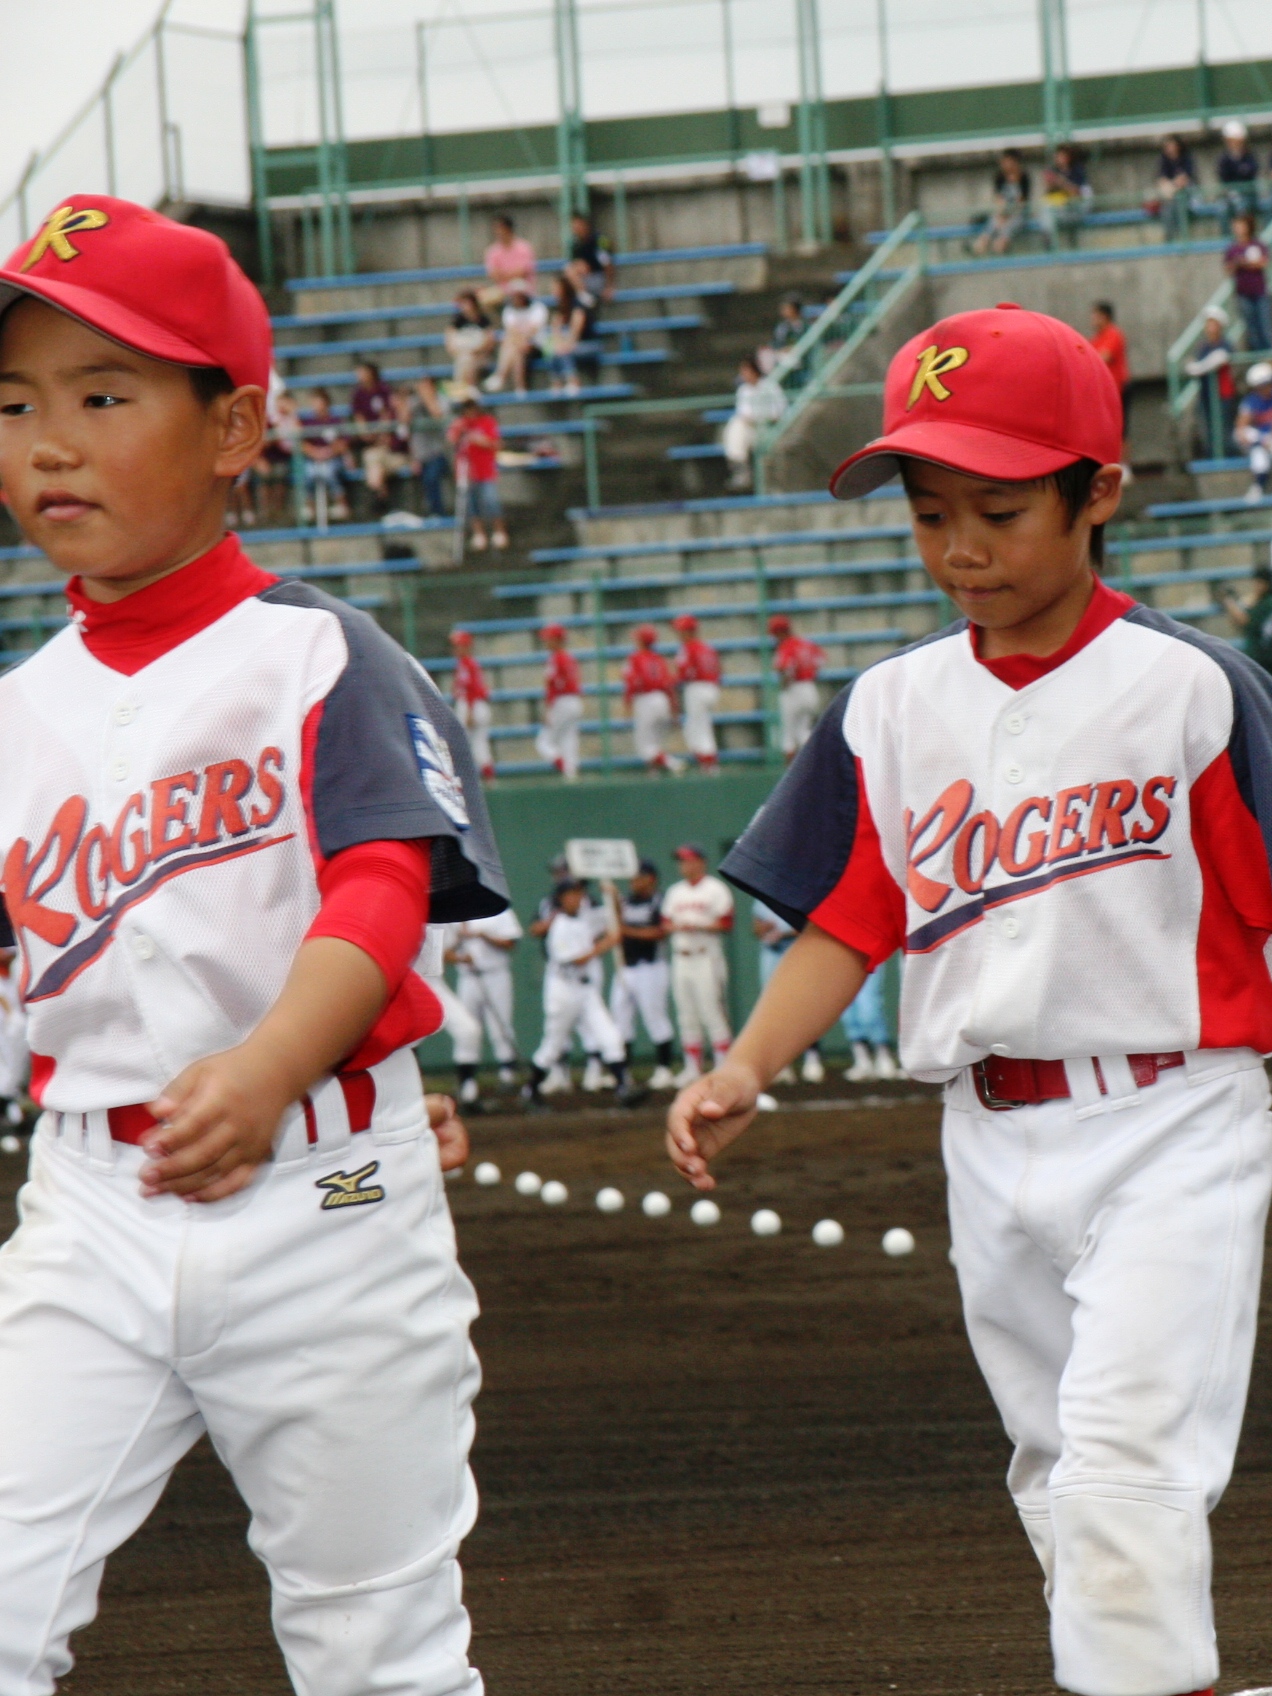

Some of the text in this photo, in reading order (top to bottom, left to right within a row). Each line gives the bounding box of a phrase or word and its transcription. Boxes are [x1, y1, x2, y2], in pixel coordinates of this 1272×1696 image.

[20, 206, 109, 274] R
[905, 344, 969, 413] R
[0, 745, 286, 1008] ROGERS
[905, 774, 1177, 914] ROGERS
